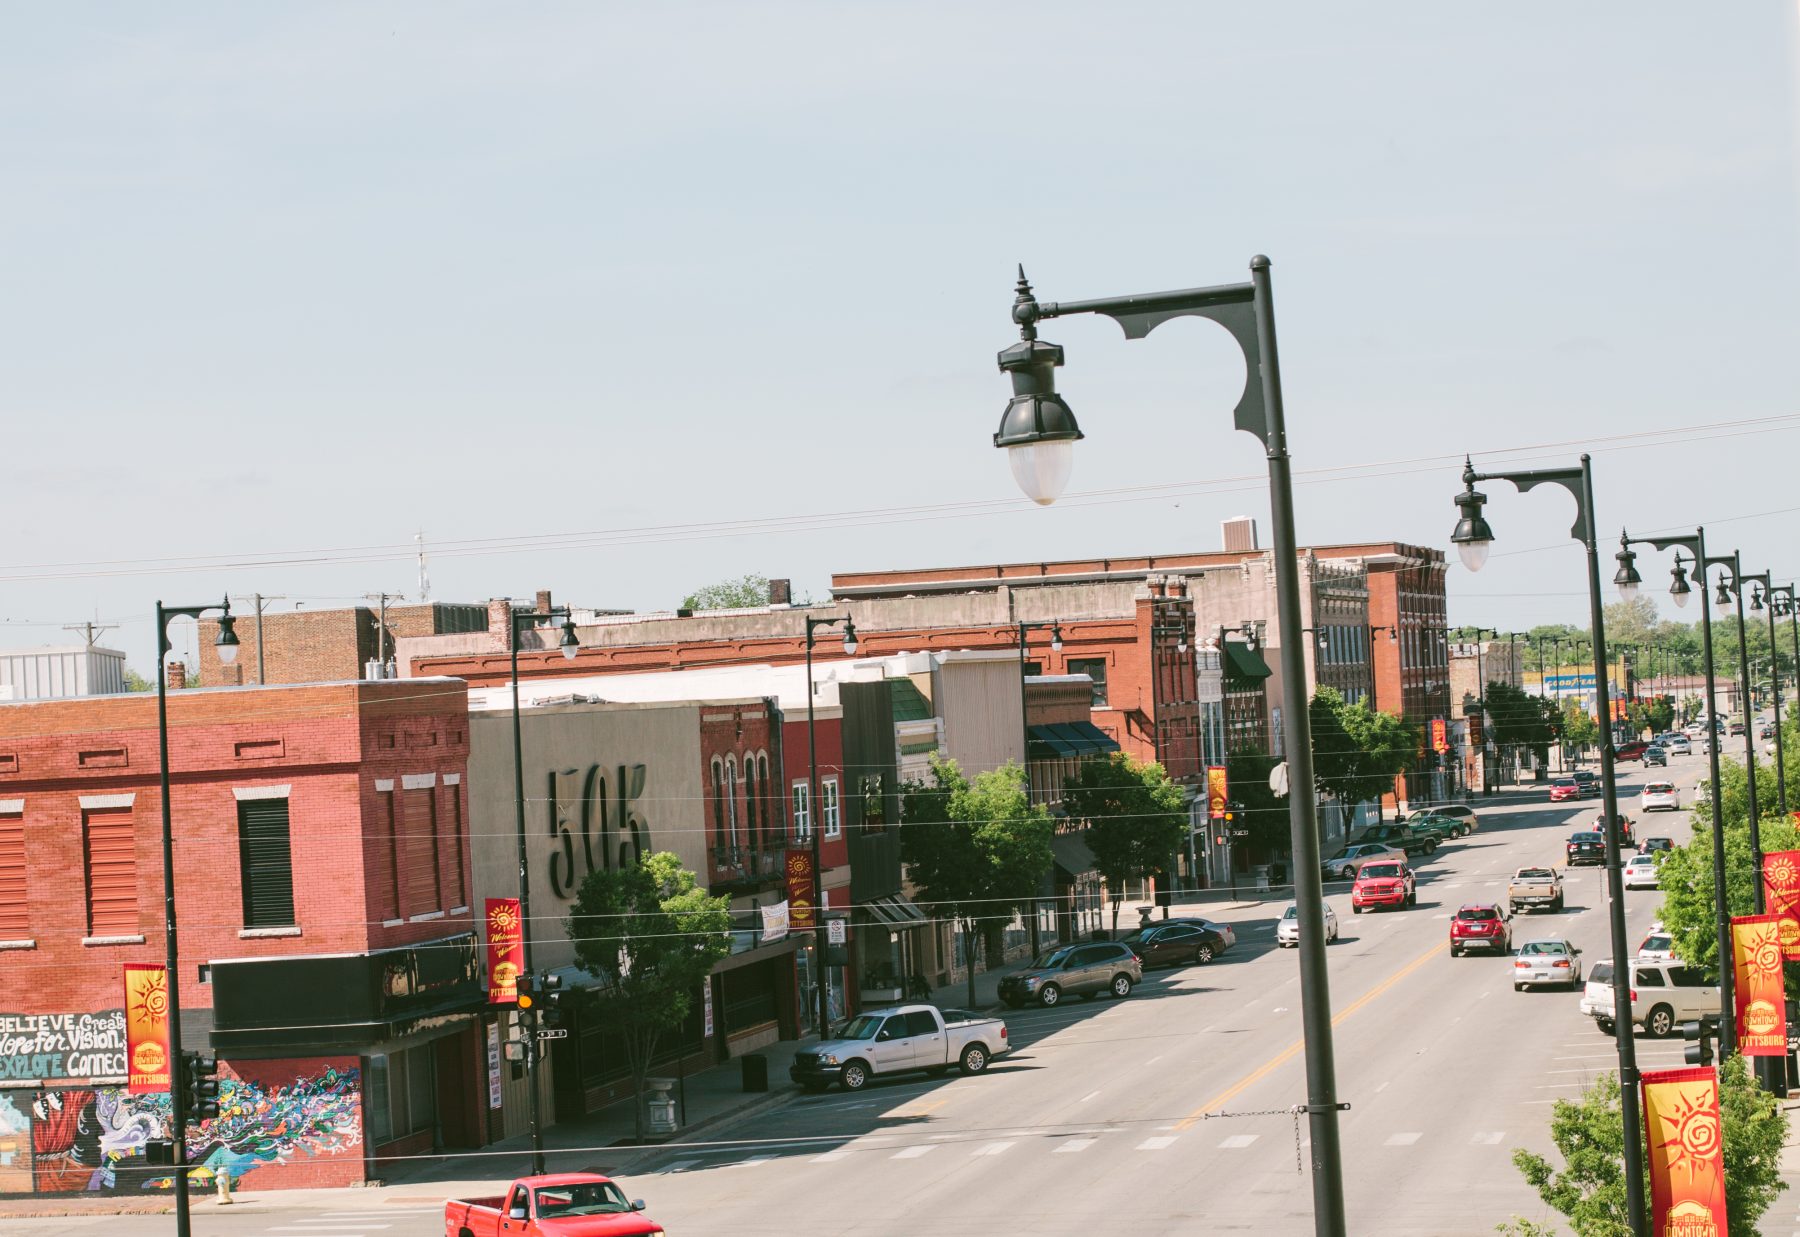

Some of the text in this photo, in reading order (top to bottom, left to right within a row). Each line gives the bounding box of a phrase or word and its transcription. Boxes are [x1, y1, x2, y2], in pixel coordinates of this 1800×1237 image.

[548, 764, 652, 900] 505
[1743, 1014, 1779, 1026] DOWNTOWN
[1740, 1035, 1784, 1048] PITTSBURG
[130, 1074, 169, 1085] PITTSBURG
